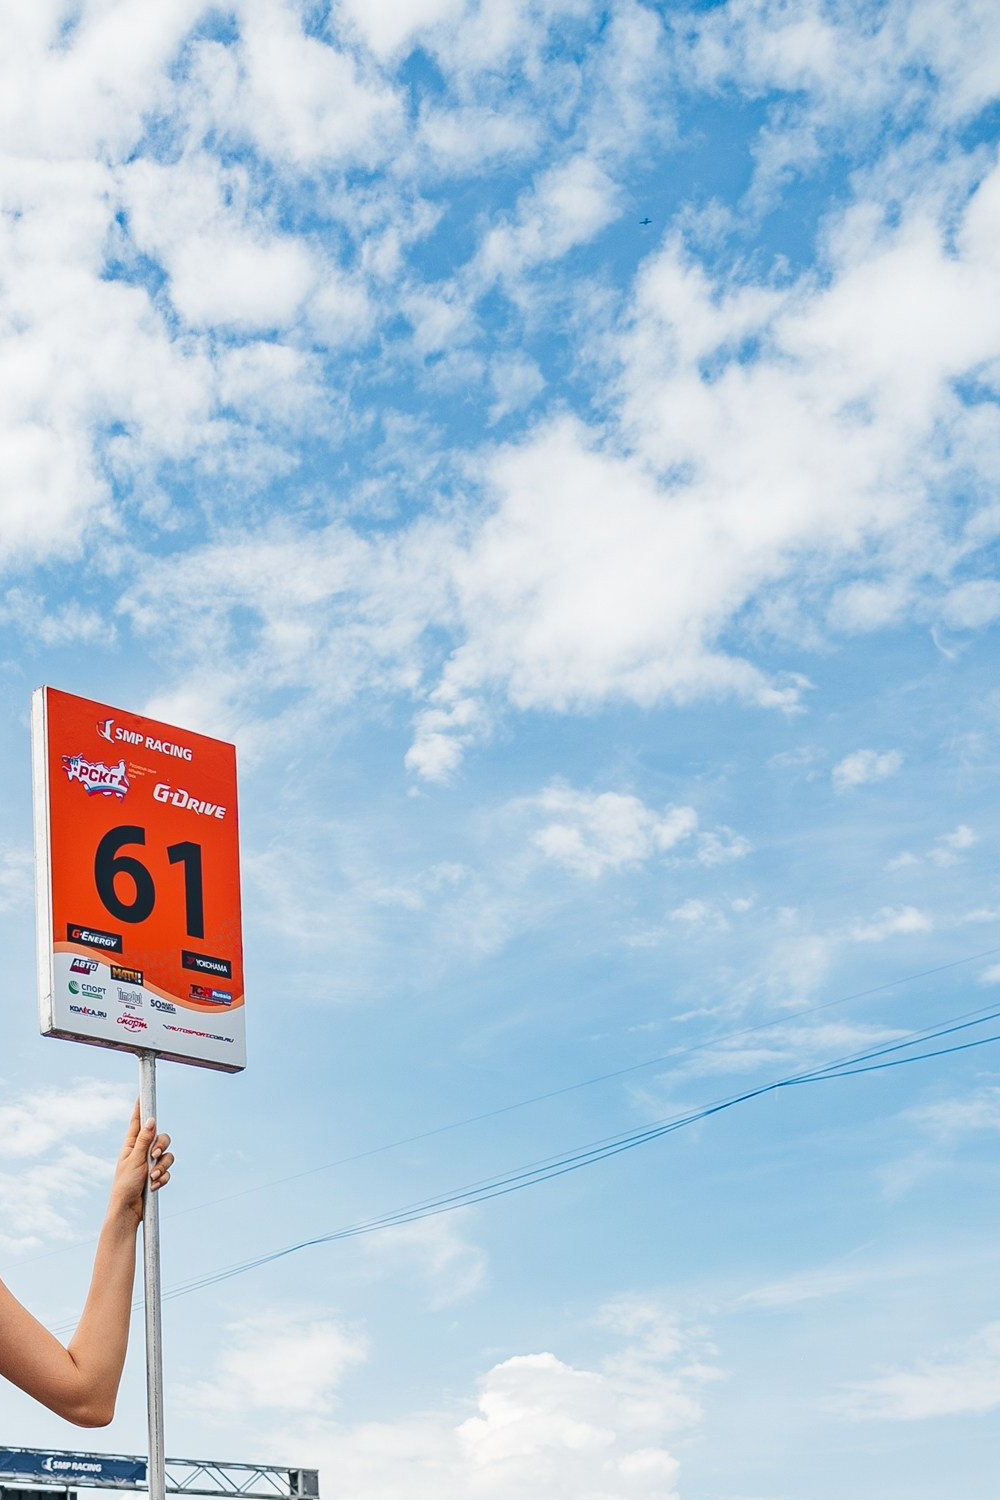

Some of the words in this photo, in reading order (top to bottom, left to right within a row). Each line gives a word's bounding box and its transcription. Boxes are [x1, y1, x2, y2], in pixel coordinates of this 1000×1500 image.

[115, 727, 143, 744] SMP
[145, 736, 193, 761] RACING
[79, 766, 118, 783] РСКГ
[94, 825, 204, 939] 61
[195, 959, 228, 973] YOKOHAMA
[81, 983, 107, 995] СПОРТ
[53, 1461, 71, 1470] SMP
[71, 1462, 102, 1472] RACING
